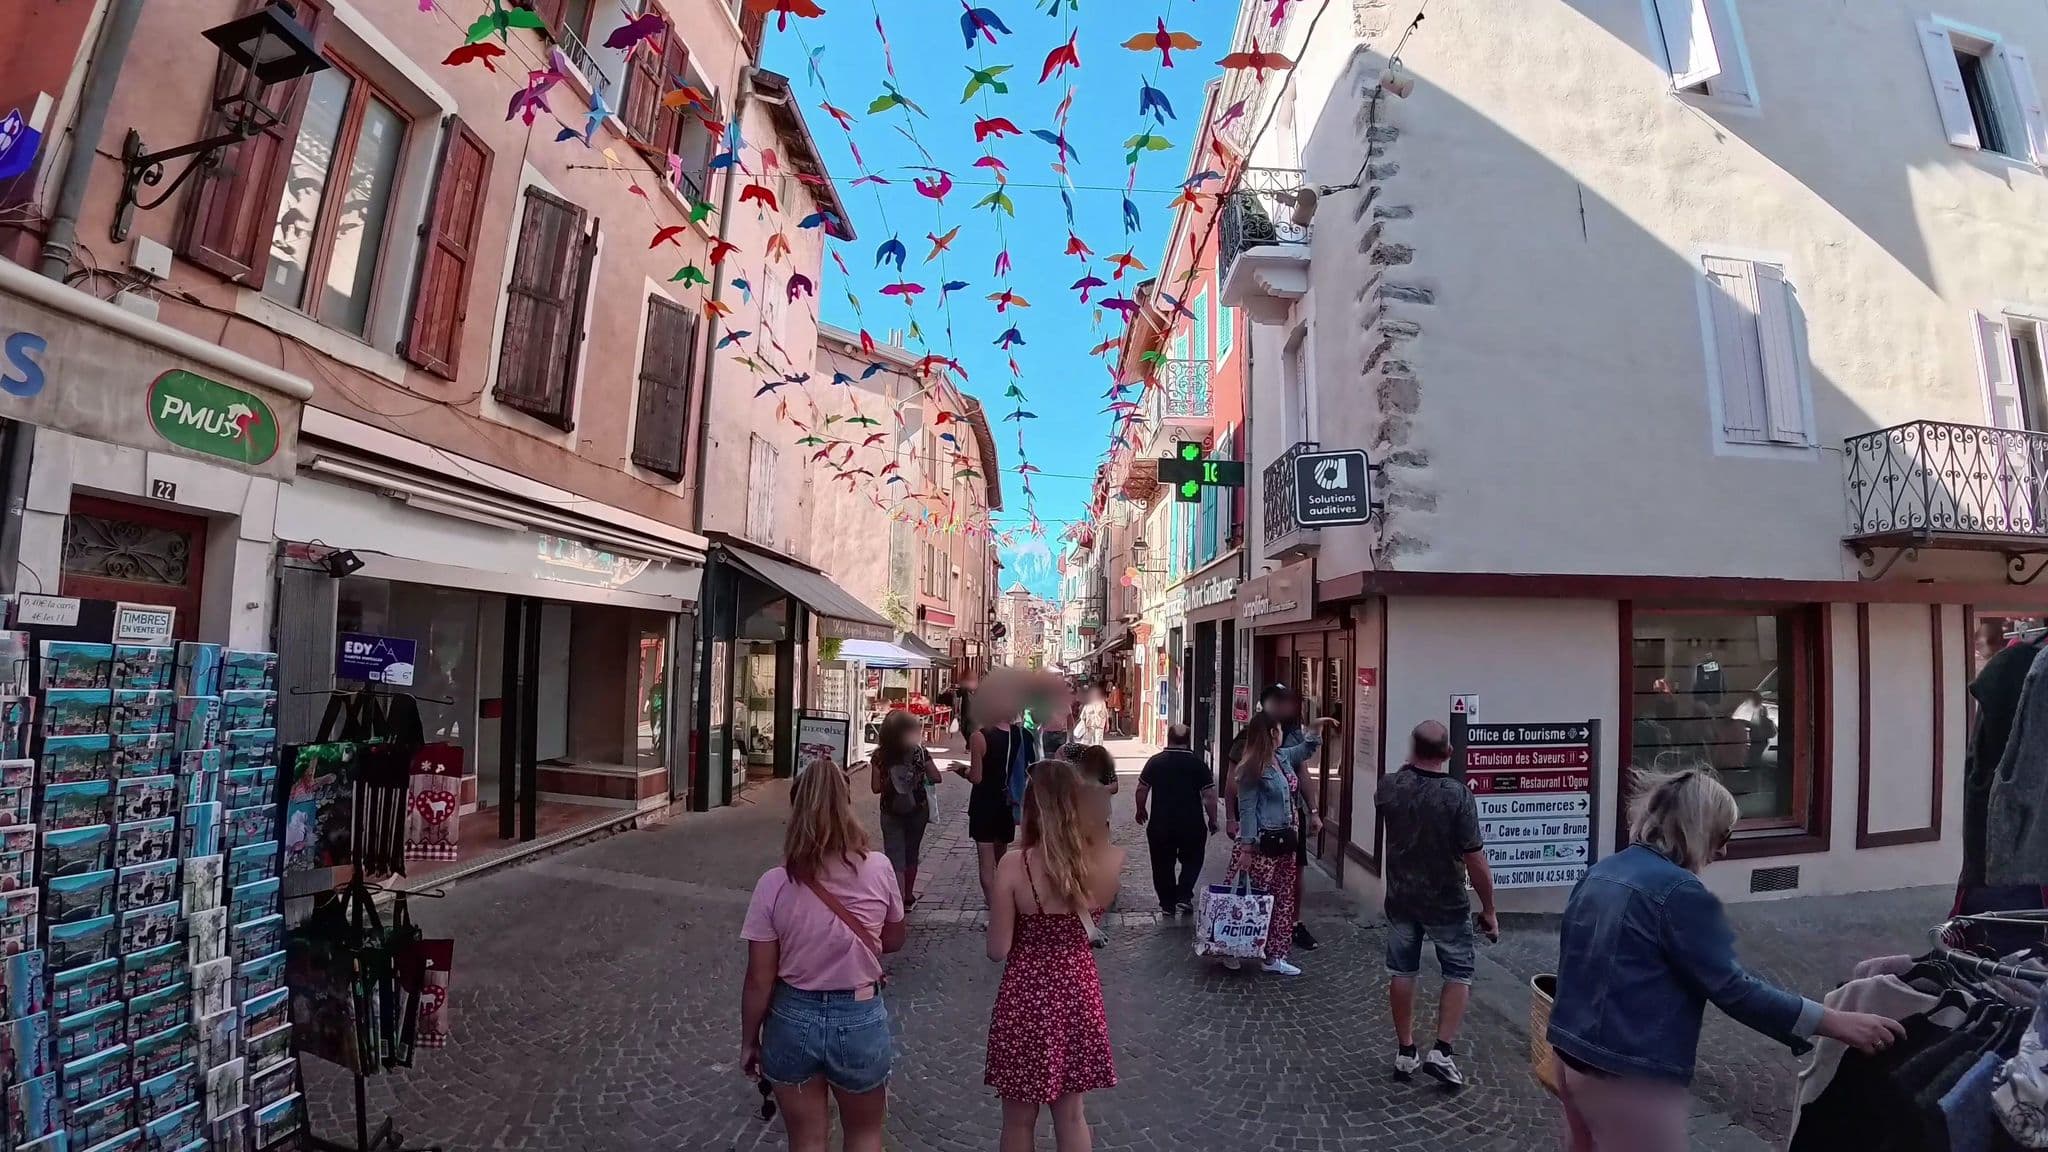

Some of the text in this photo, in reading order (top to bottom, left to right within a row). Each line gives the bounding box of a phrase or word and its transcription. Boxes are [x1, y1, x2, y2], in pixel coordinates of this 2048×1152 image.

[160, 394, 224, 434] PMU
[156, 481, 173, 499] 22
[1308, 494, 1356, 504] Solutions
[1309, 505, 1357, 516] auditives
[123, 612, 167, 625] TIMBRES
[121, 625, 132, 633] EN
[132, 625, 155, 634] VENTE
[344, 641, 373, 656] EDY
[1468, 728, 1566, 742] Office de Tourisme
[1467, 751, 1566, 766] L'Emulsion des Saveurs
[1520, 776, 1561, 789] Restaurant
[1481, 800, 1575, 814] Tous Commerces
[1499, 825, 1521, 837] Cave
[1522, 827, 1531, 836] de
[1532, 827, 1539, 836] la
[1541, 823, 1560, 836] Tour
[1563, 822, 1588, 835] Brune
[1515, 848, 1541, 861] Levain
[1493, 872, 1510, 885] Vous
[1511, 871, 1534, 884] SICOM
[1221, 924, 1261, 937] ACTION
